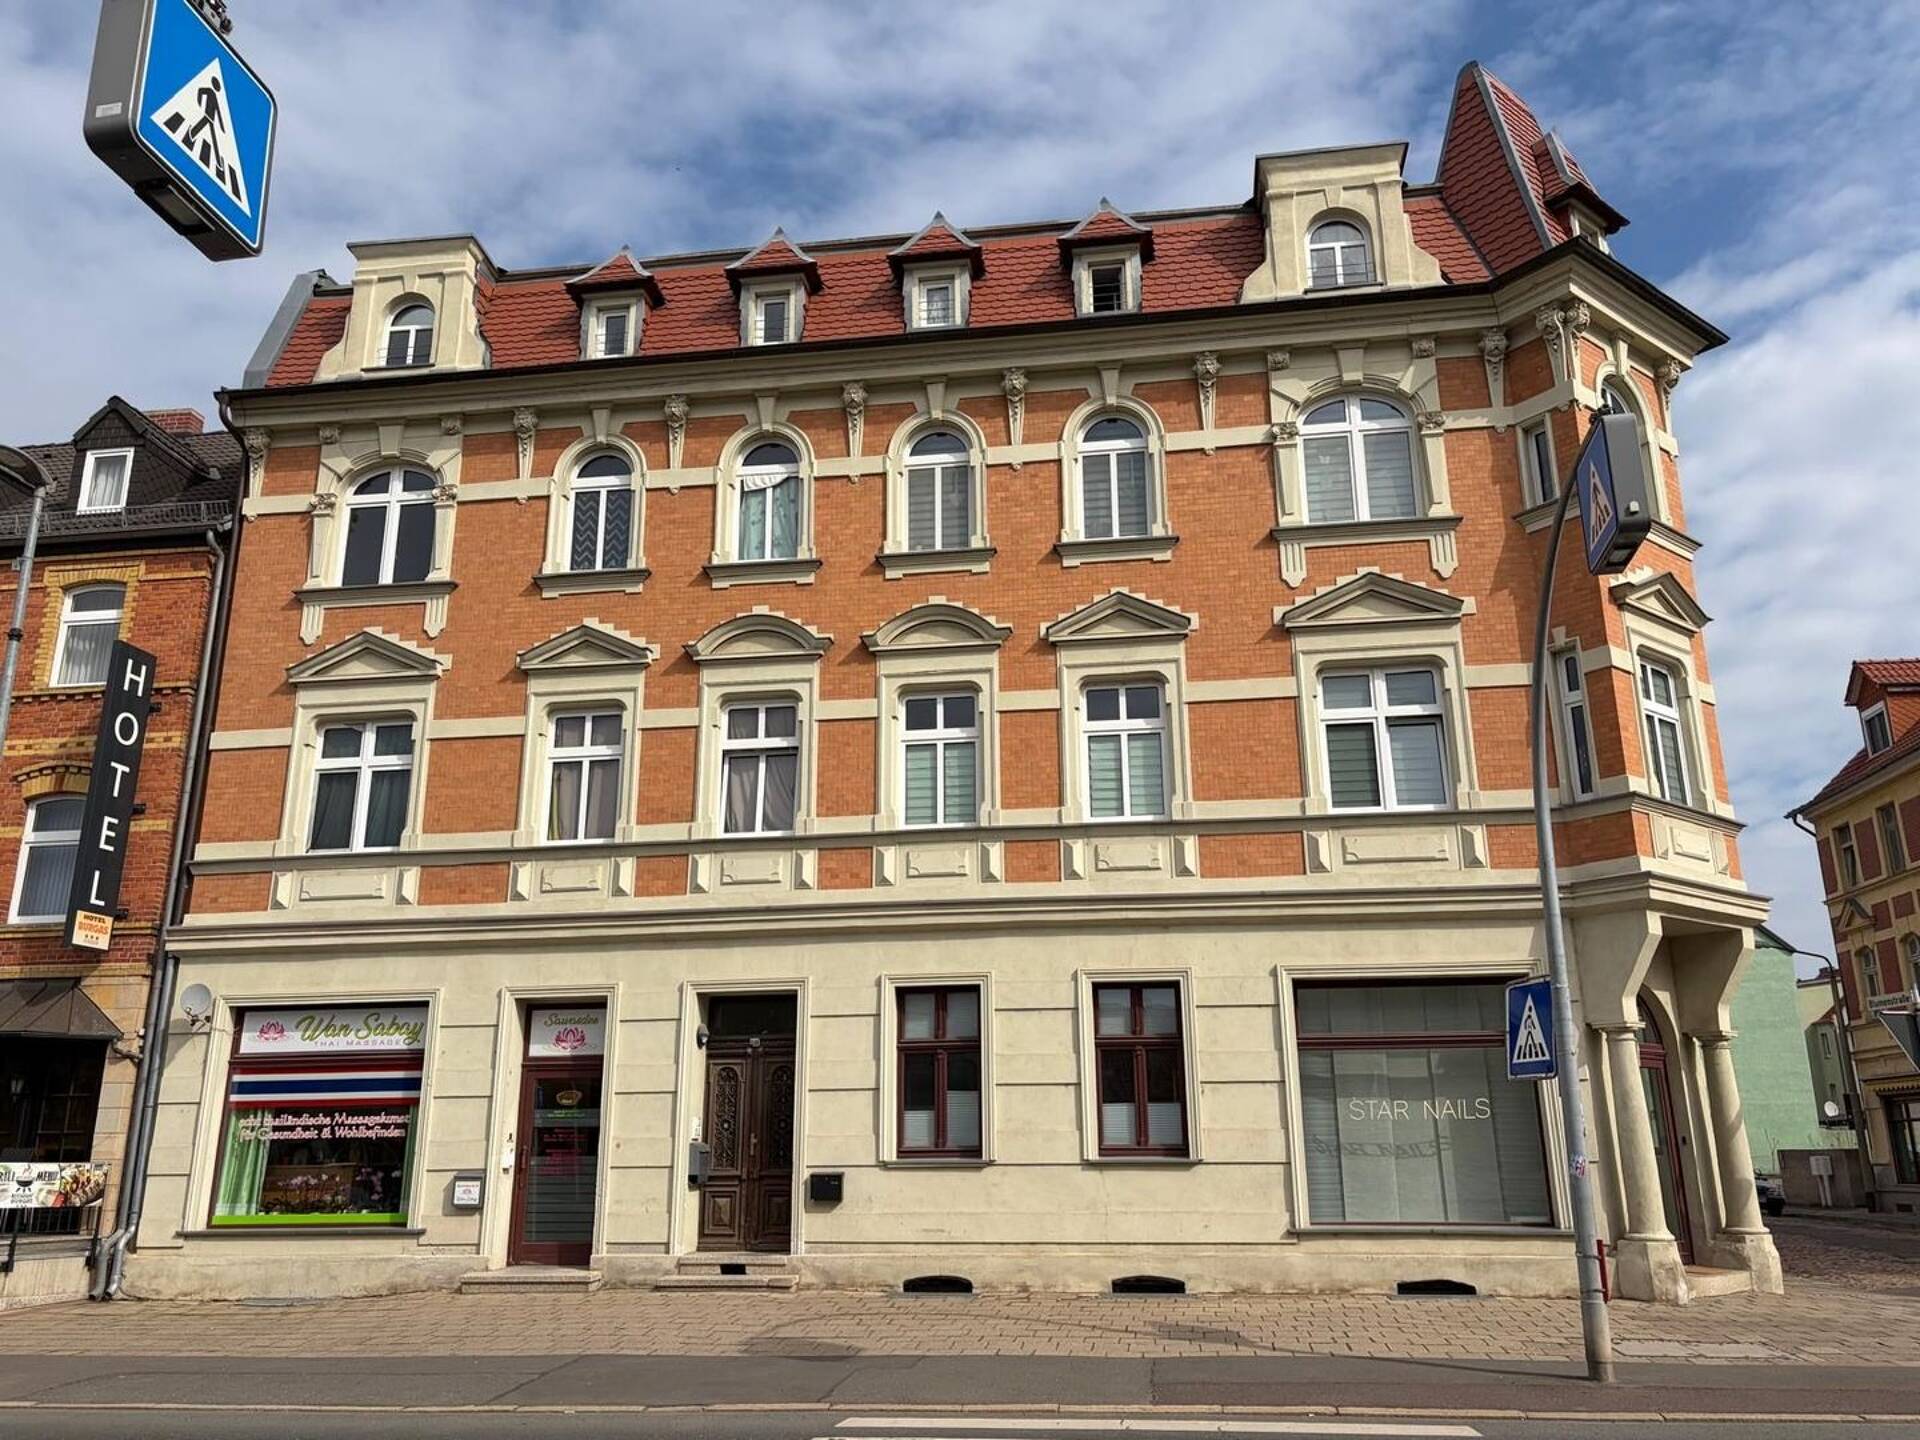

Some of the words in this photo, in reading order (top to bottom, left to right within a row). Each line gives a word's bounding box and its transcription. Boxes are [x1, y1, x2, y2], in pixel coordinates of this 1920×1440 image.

[90, 659, 147, 907] HOTEL
[83, 914, 106, 924] HOTEL
[78, 921, 109, 935] BURGAS
[295, 1014, 352, 1042] Wan
[353, 1012, 426, 1046] Sabay
[314, 1040, 341, 1048] THAI
[346, 1038, 401, 1047] MASSAGE
[1350, 1099, 1410, 1121] STAR
[1423, 1098, 1491, 1120] NAILS
[263, 1113, 331, 1127] thailändische
[258, 1126, 319, 1141] Gesundheit
[335, 1125, 405, 1141] Wohlbefinden
